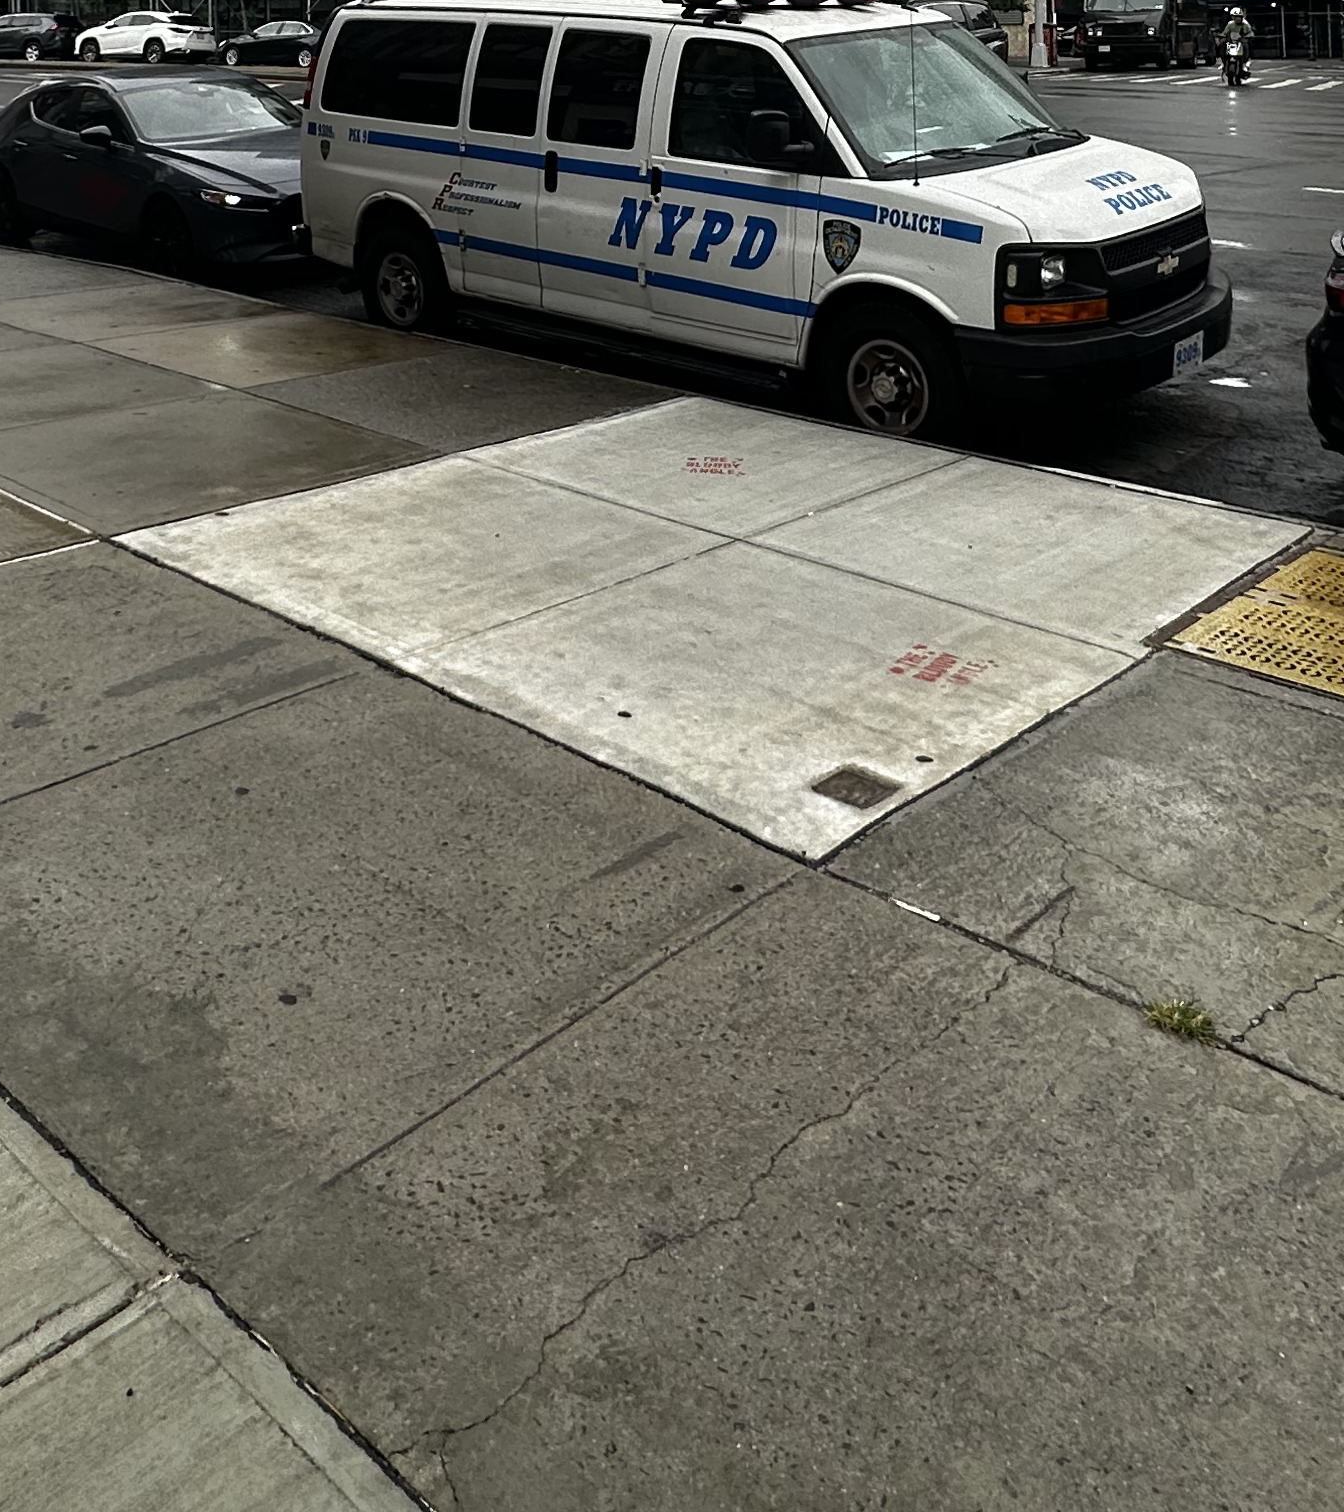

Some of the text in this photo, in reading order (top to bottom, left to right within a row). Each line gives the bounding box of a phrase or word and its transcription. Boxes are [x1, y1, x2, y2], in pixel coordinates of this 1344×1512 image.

[1086, 170, 1137, 192] NYPD
[1103, 183, 1173, 216] POLICE
[607, 196, 778, 271] NYPD
[876, 205, 942, 237] POLICE
